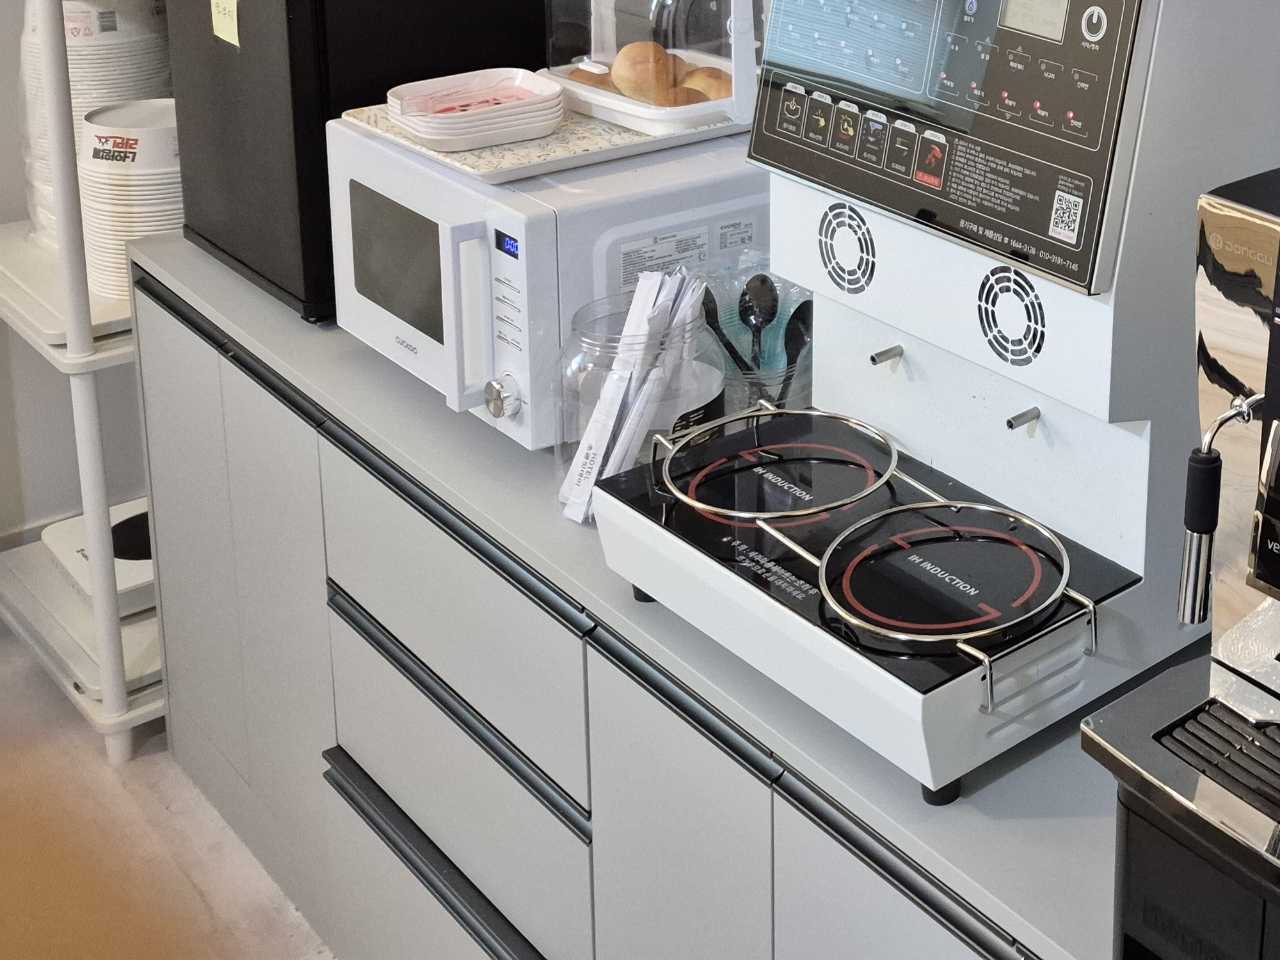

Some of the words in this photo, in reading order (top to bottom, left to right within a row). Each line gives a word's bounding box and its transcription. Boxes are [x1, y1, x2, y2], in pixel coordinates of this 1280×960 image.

[763, 468, 814, 502] INDUCTION
[907, 553, 921, 564] IH
[920, 557, 980, 597] INDUCTION
